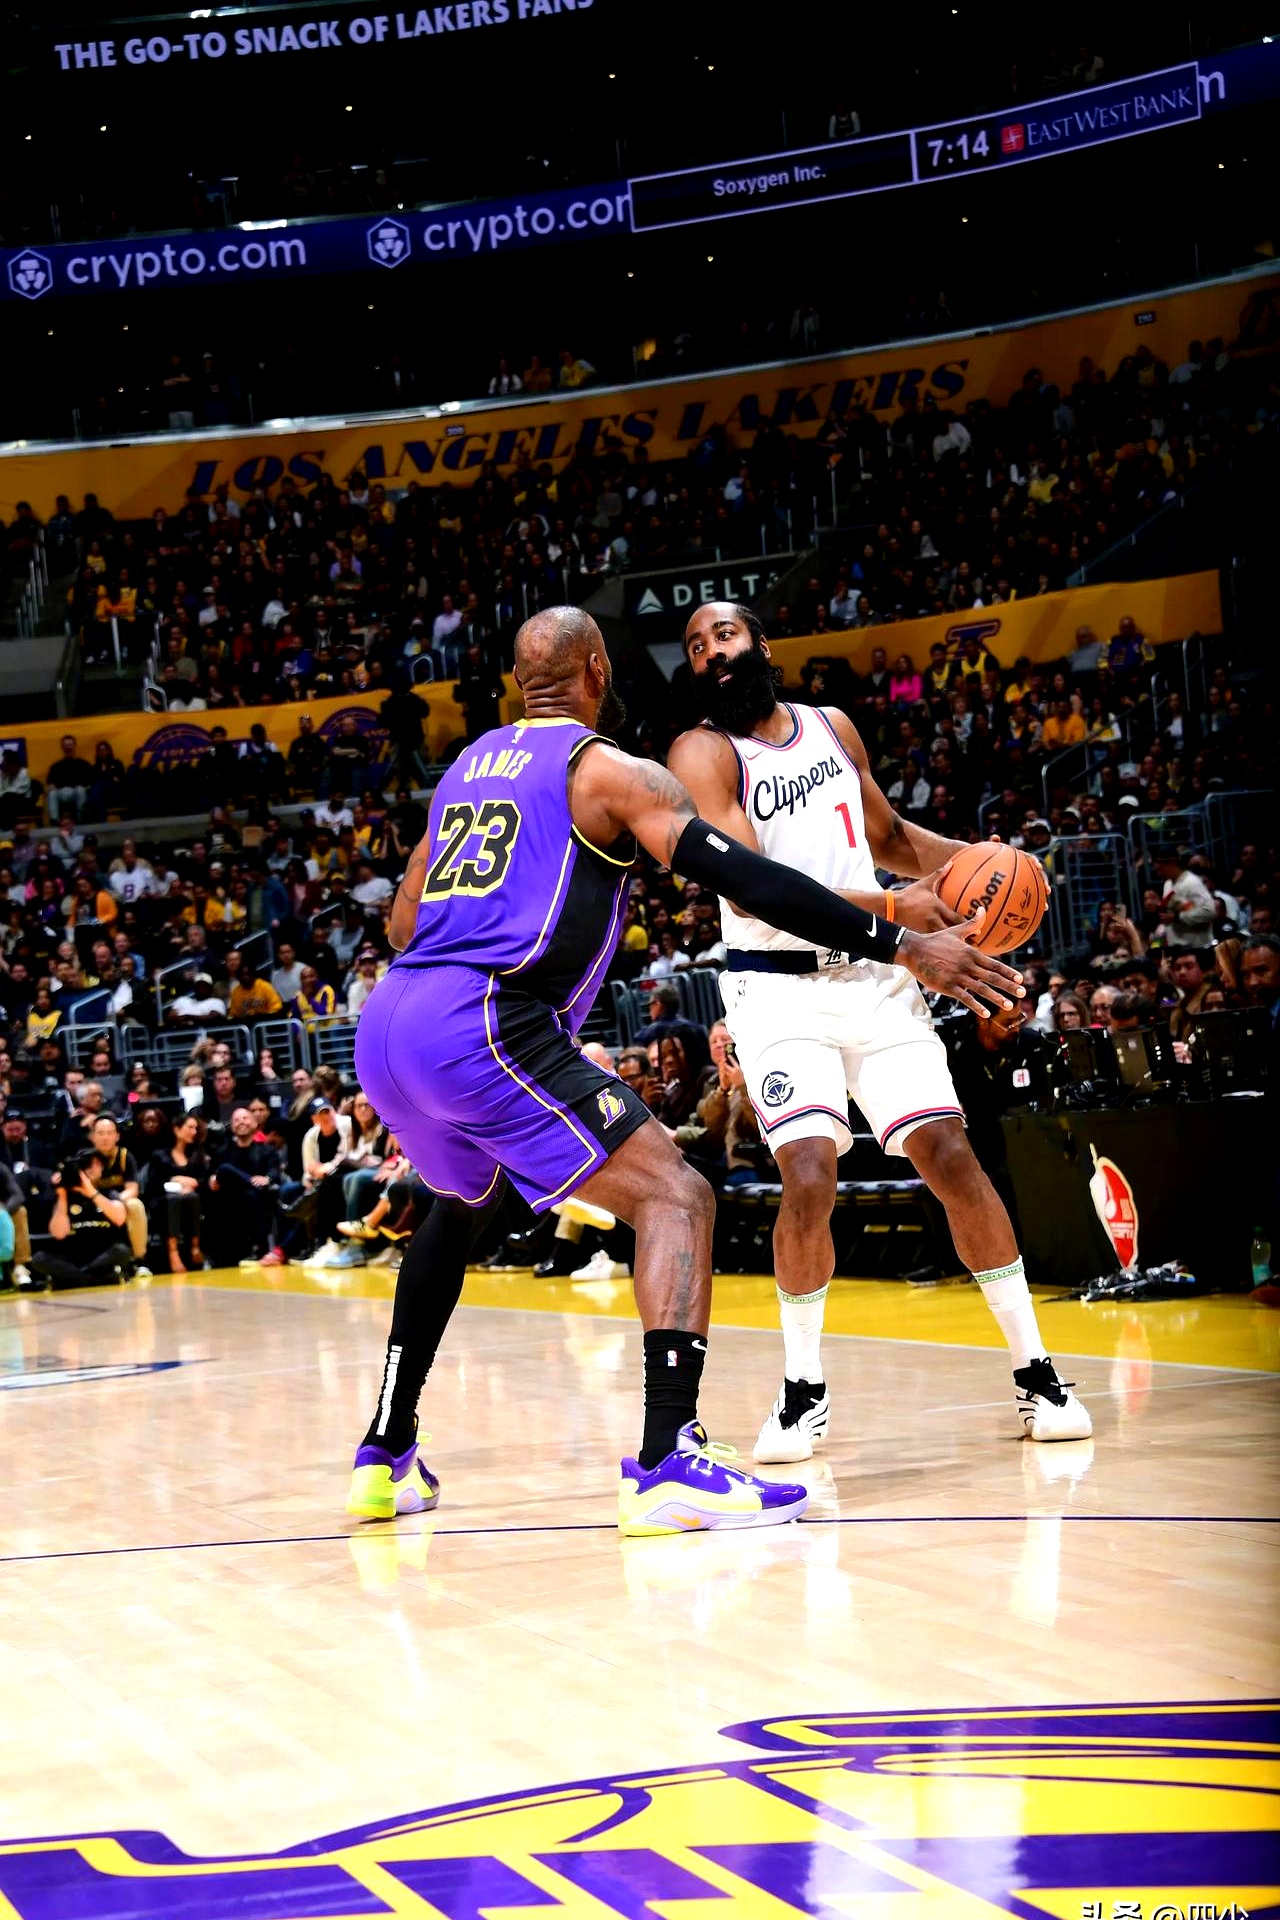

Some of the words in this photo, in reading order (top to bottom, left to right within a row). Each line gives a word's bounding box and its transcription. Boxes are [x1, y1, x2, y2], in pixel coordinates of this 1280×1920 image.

[54, 41, 117, 70] THE
[124, 32, 227, 64] GO-TO
[234, 20, 342, 56] SNACK
[348, 16, 389, 44] OF
[395, 0, 510, 39] LAKERS
[927, 130, 990, 167] 7:14
[713, 171, 789, 196] Soxygen
[793, 166, 827, 182] Inc.
[66, 239, 307, 287] crypto.com
[188, 451, 325, 495] LOS
[338, 410, 658, 480] ANGELES
[676, 359, 970, 440] LAKERS
[463, 749, 533, 783] JAMES
[753, 755, 843, 822] Clippers
[834, 802, 857, 849] 1
[421, 800, 522, 903] 23
